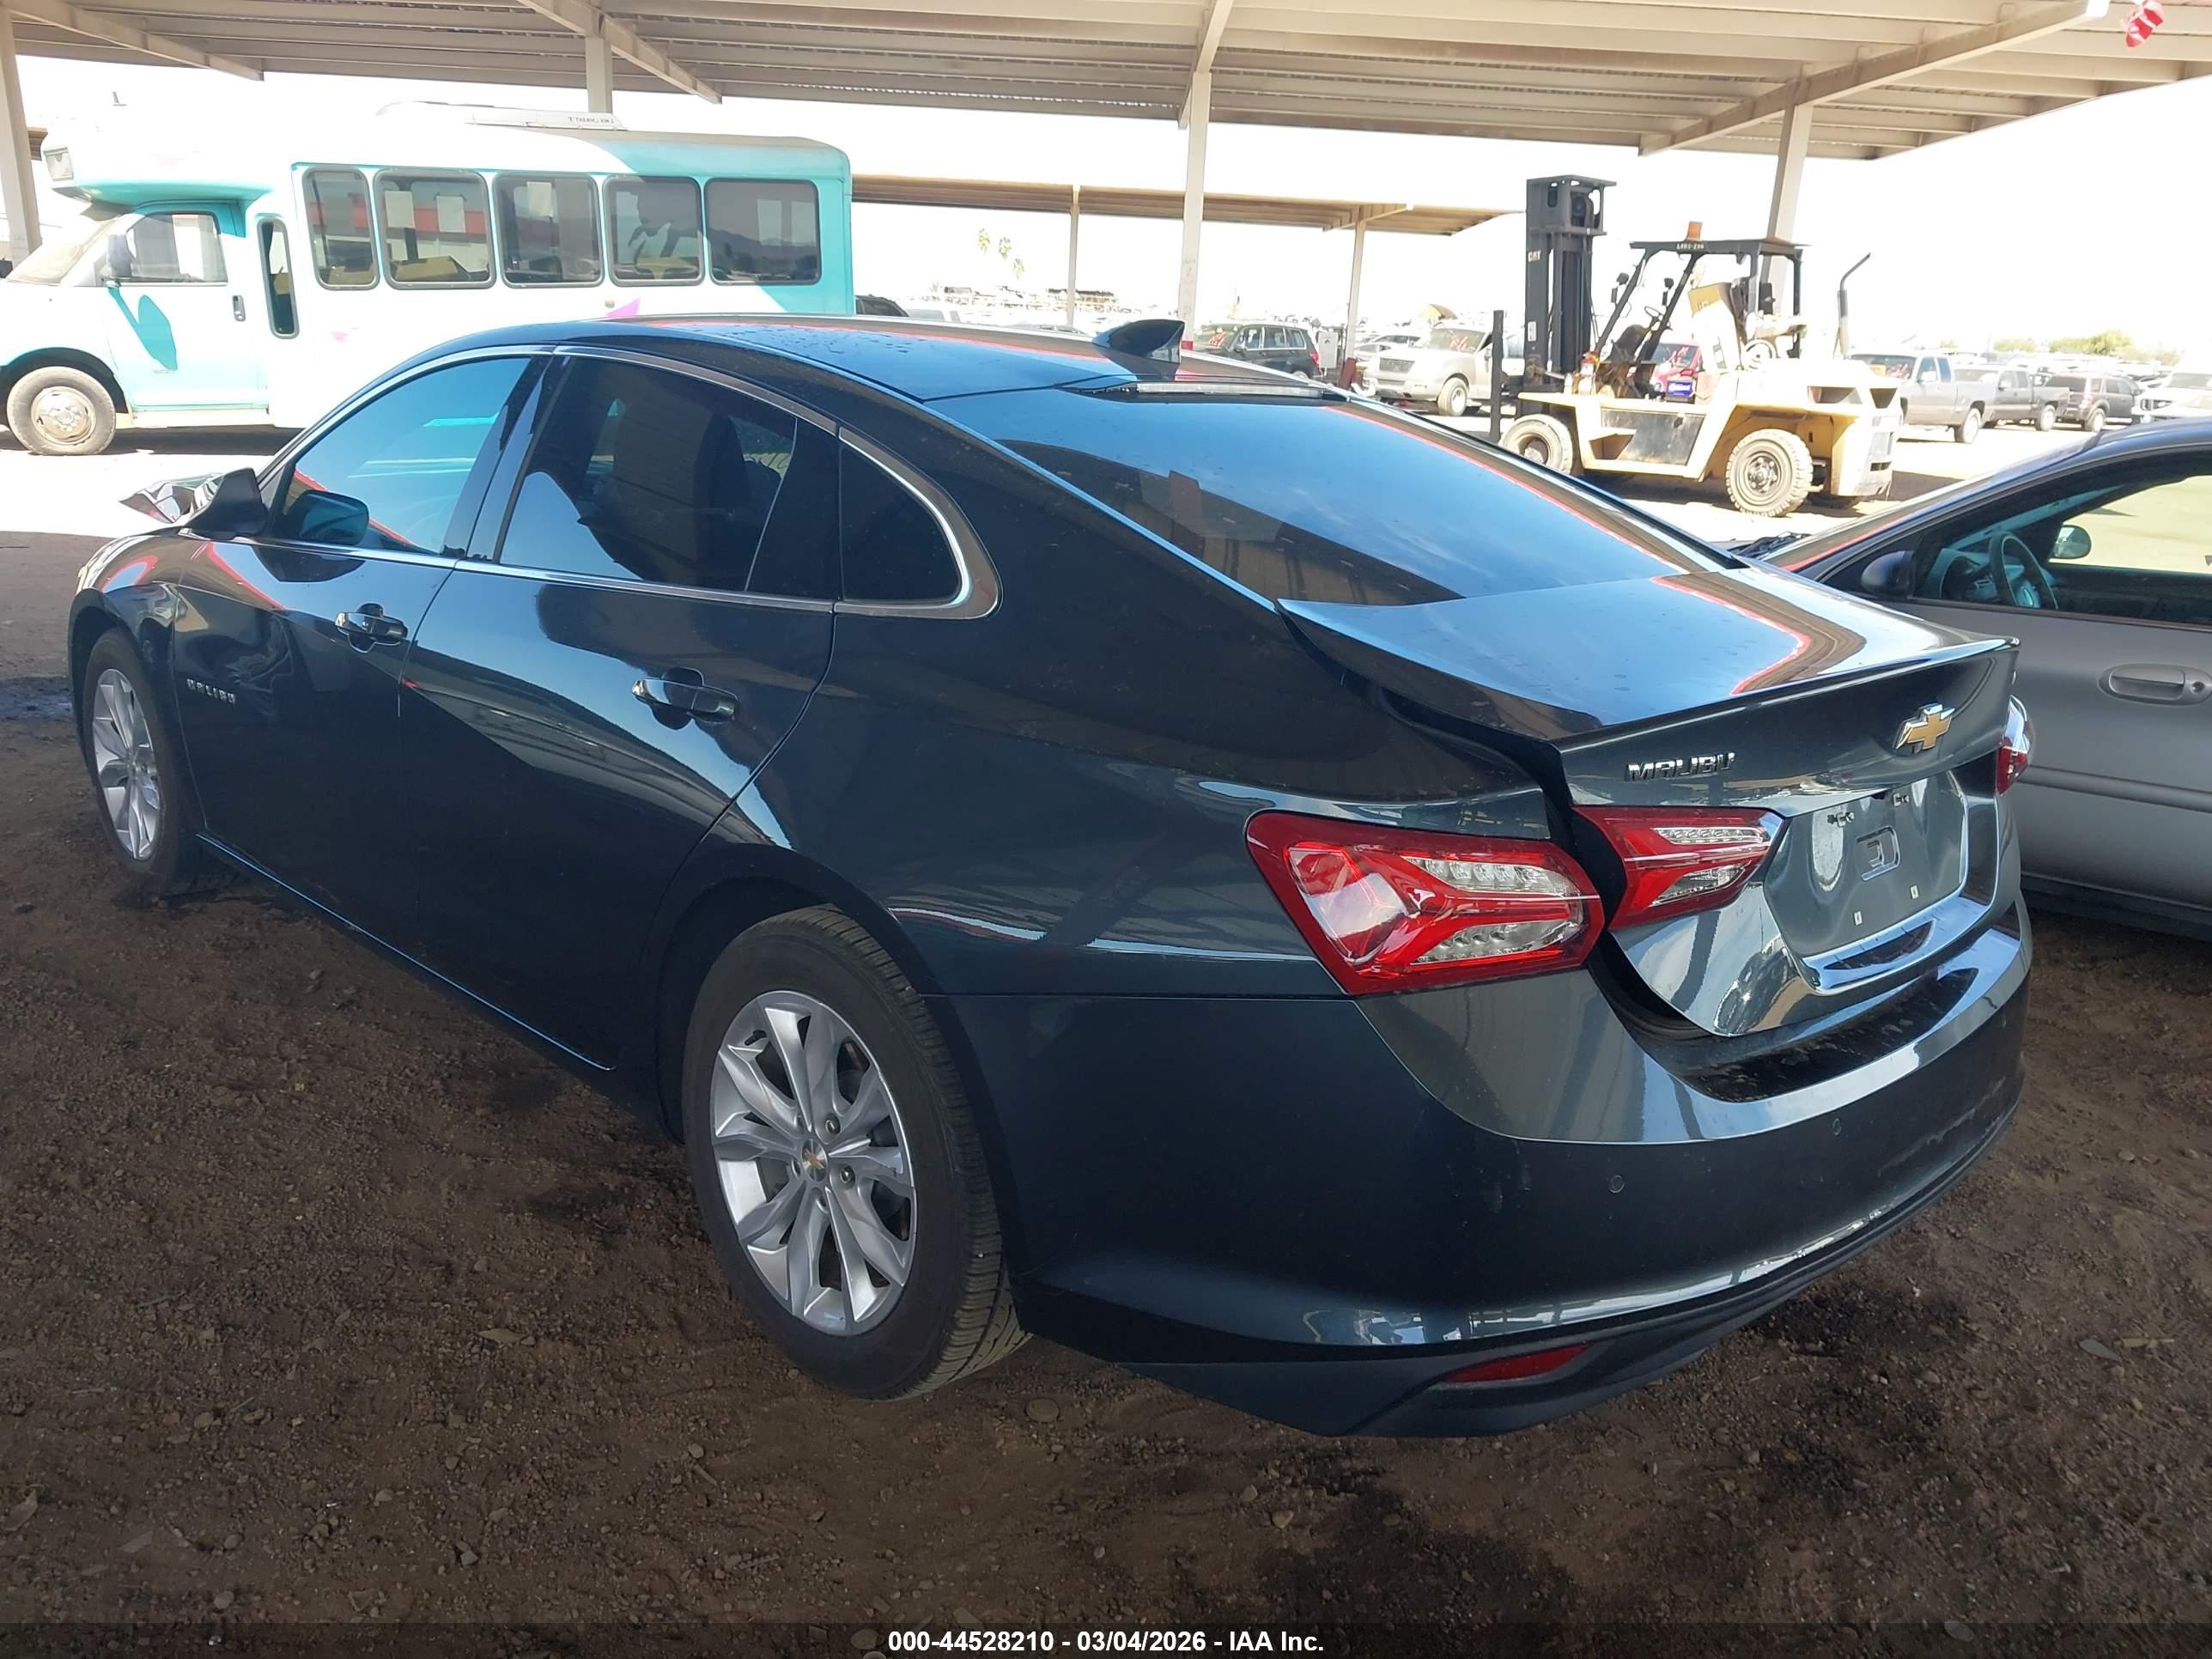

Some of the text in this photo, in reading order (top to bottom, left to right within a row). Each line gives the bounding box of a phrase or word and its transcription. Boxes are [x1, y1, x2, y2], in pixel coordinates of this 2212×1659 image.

[1528, 250, 1541, 262] CAT
[186, 678, 235, 704] MALIBU
[1626, 752, 1735, 781] MALIBU
